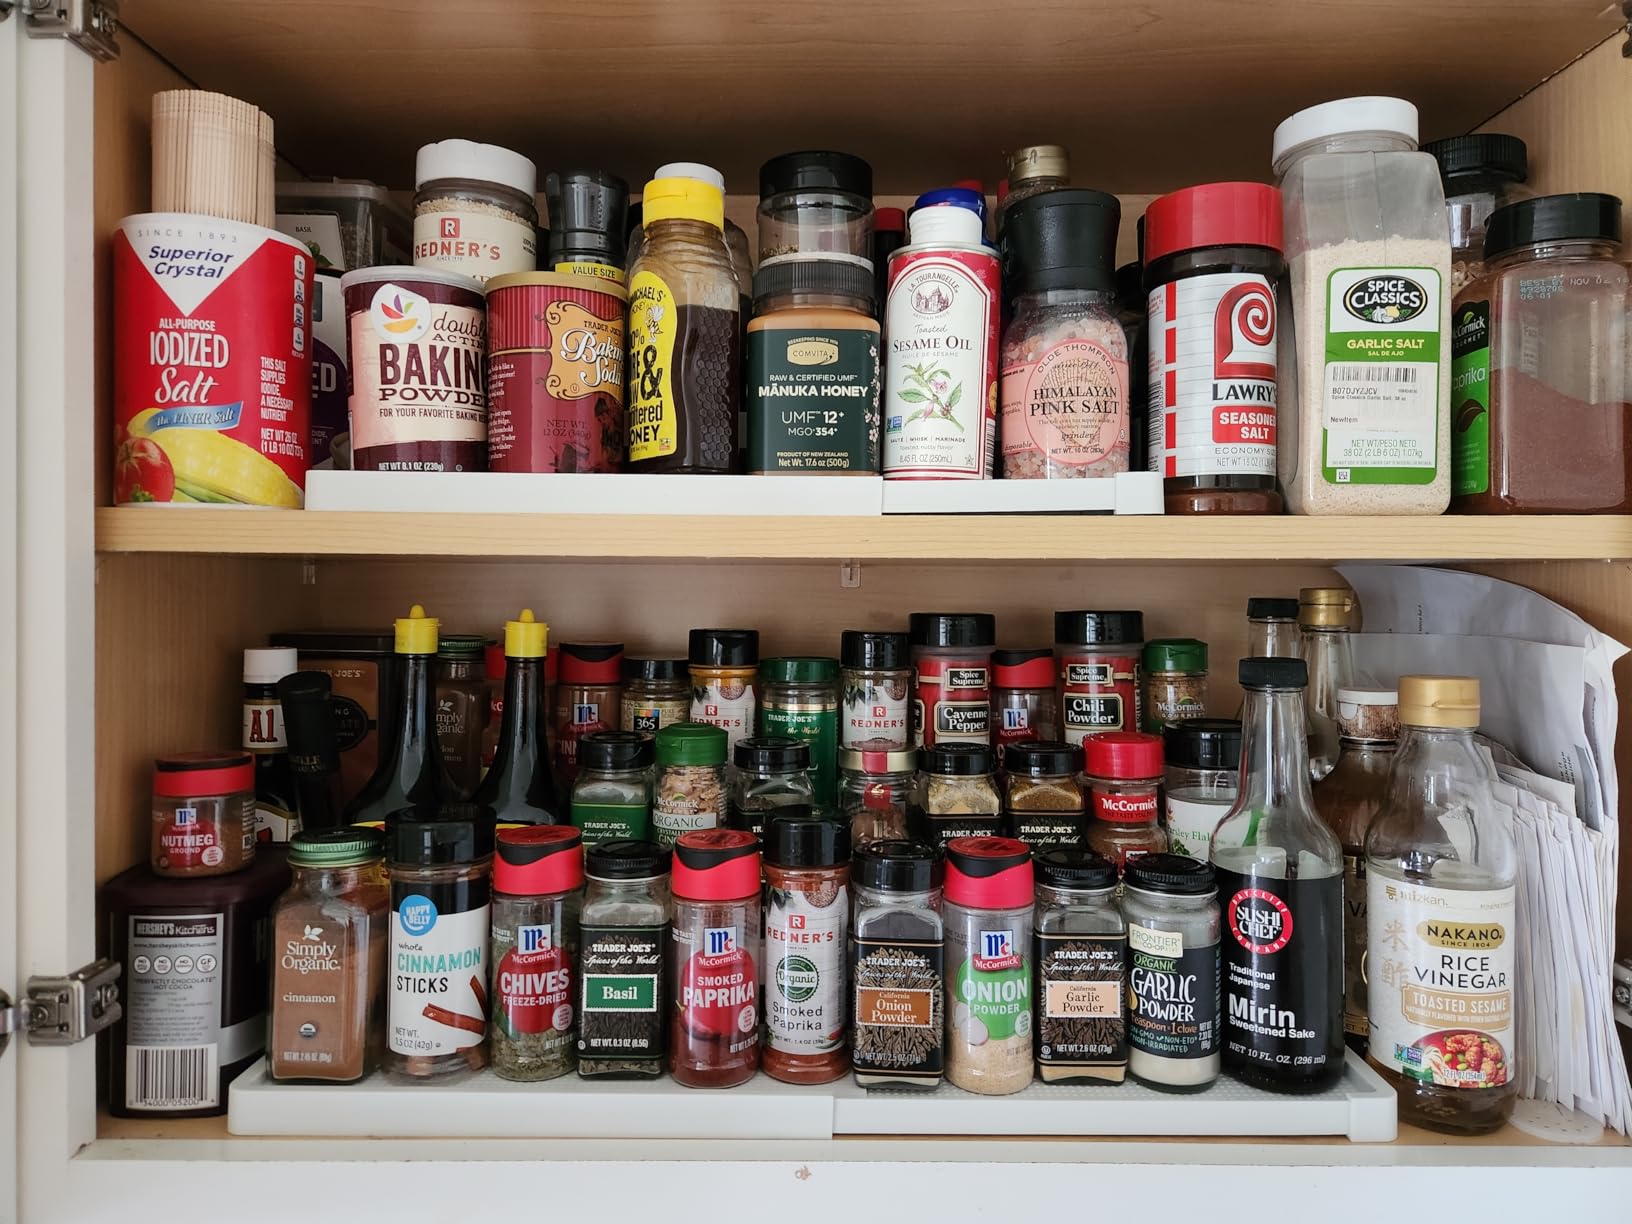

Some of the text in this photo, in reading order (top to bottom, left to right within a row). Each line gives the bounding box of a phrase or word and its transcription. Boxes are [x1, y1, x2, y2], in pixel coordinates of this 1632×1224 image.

[137, 229, 183, 237] SINCE
[149, 246, 233, 263] Superior
[415, 241, 501, 261] REDNER'S
[154, 262, 224, 278] Crystal
[572, 266, 616, 278] VALUE SIZE
[908, 272, 959, 293] LA TOURANGELLE
[1367, 280, 1406, 293] SPICE
[1350, 291, 1421, 308] CLASSICS
[159, 318, 216, 332] ALL-PURPOSE
[915, 324, 948, 334] Toasted
[150, 331, 230, 368] IODIZED
[1347, 339, 1425, 349] GARLIC SALT
[1037, 343, 1116, 375] OLDE THOMPSON
[260, 370, 286, 385] SUPPLIES
[796, 374, 836, 382] CERTIFIED
[155, 367, 219, 404] Salt
[758, 383, 868, 397] MĀNUKA HONEY
[1034, 386, 1117, 400] HIMALAYAN
[261, 408, 287, 422] NUTRIENT
[380, 408, 393, 417] FOR
[395, 408, 416, 417] YOUR
[420, 408, 454, 419] FAVORITE
[1030, 400, 1076, 416] PINK
[1082, 400, 1119, 415] SALT
[1241, 427, 1269, 439] SALT
[778, 459, 789, 467] Net
[790, 459, 804, 467] Wt.
[805, 459, 817, 467] 17.6
[827, 459, 849, 468] (500g)
[959, 670, 980, 679] Spice
[1071, 673, 1105, 681] Supreme
[1076, 665, 1098, 675] Spice
[952, 677, 983, 686] Supreme
[1073, 699, 1105, 712] Chili
[1156, 702, 1204, 710] McCormick
[768, 714, 790, 722] TRADER
[944, 707, 988, 720] Cayenne
[1067, 711, 1114, 724] Powder
[636, 718, 655, 729] 365
[851, 719, 904, 728] REDNER'S
[948, 718, 986, 732] Pepper
[1000, 728, 1031, 738] McCormick
[657, 796, 698, 808] McCormick
[1101, 797, 1158, 812] McCormick
[584, 821, 627, 830] TRADER JOE'S
[655, 814, 703, 827] ORGANIC
[1021, 825, 1073, 834] TRADER JOE'S
[161, 833, 214, 846] NUTMEG
[1232, 888, 1290, 913] BAYCLIFF
[406, 904, 430, 914] HAPPY
[1236, 905, 1281, 926] SUSHI
[409, 915, 430, 926] BELLY
[136, 923, 215, 935] HERSHEY'S Kitchens
[768, 927, 834, 944] REDNER'S
[1239, 921, 1278, 940] CHEF
[1427, 924, 1499, 940] NAKANO
[1132, 930, 1178, 945] FRONTIER
[1232, 927, 1287, 954] COMPANY
[1441, 940, 1466, 948] SINCE
[286, 940, 337, 959] Simply
[399, 943, 423, 952] whole
[592, 943, 651, 952] TRADER JOE'S
[1143, 941, 1164, 950] CO-OP
[397, 946, 481, 974] CINNAMON
[512, 951, 552, 965] McCormick
[699, 952, 740, 967] McCormick
[867, 957, 925, 967] TRADER JOE'S
[1054, 951, 1113, 959] TRADER JOE'S
[1134, 953, 1176, 971] ORGANIC
[974, 956, 1018, 969] McCormick
[1441, 954, 1490, 972] RICE
[1229, 962, 1275, 981] Traditional
[1414, 966, 1507, 989] VINEGAR
[396, 976, 449, 993] STICKS
[501, 967, 569, 995] CHIVES
[698, 973, 744, 985] SMOKED
[1132, 968, 1197, 1003] GARLIC
[1229, 973, 1271, 991] Japanese
[602, 986, 637, 1001] Basil
[683, 981, 755, 1008] PAPRIKA
[962, 977, 1027, 999] ONION
[283, 993, 336, 1004] cinnamon
[502, 991, 567, 1007] FREEZE-DRIED
[1066, 992, 1100, 1002] Garlic
[1412, 992, 1466, 1013] TOASTED
[1470, 999, 1507, 1014] SESAME
[773, 1002, 823, 1017] Smoked
[876, 999, 912, 1012] Onion
[974, 1003, 1020, 1014] POWDER
[1062, 1002, 1104, 1013] Powder
[1139, 996, 1195, 1021] POWDER
[1228, 993, 1296, 1028] Mirin
[774, 1015, 822, 1031] Paprika
[871, 1009, 917, 1024] Powder
[1229, 1015, 1288, 1038] Sweetened
[1288, 1028, 1315, 1038] Sake
[591, 1039, 600, 1047] NET
[601, 1039, 612, 1047] WT.
[613, 1039, 622, 1047] 0.3
[623, 1039, 631, 1047] OZ
[1229, 1042, 1326, 1066] NET 10 FL. OZ. (296 ml)
